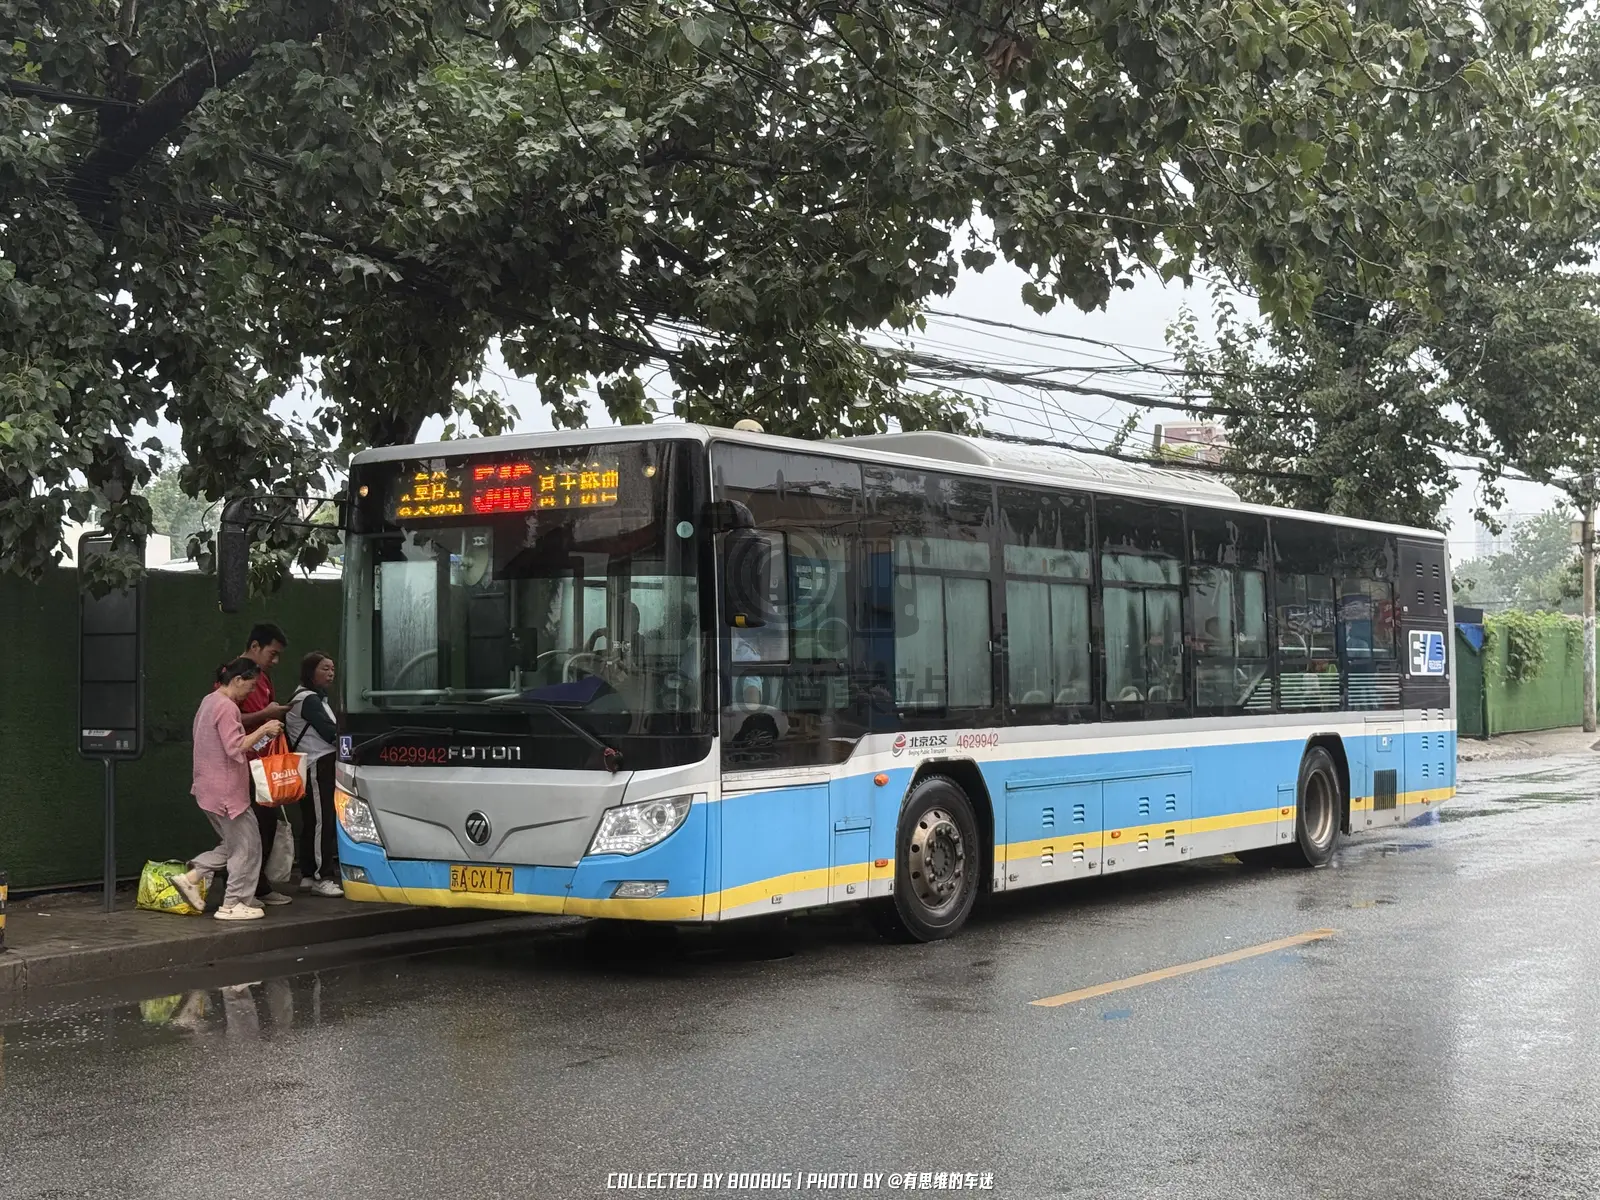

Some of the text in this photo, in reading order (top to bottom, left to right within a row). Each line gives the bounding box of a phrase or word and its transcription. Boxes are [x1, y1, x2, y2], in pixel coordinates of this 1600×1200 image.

[908, 735, 948, 748] 北京公交
[956, 733, 999, 749] 4629942
[379, 746, 447, 763] 4629942
[448, 745, 521, 760] FOTON
